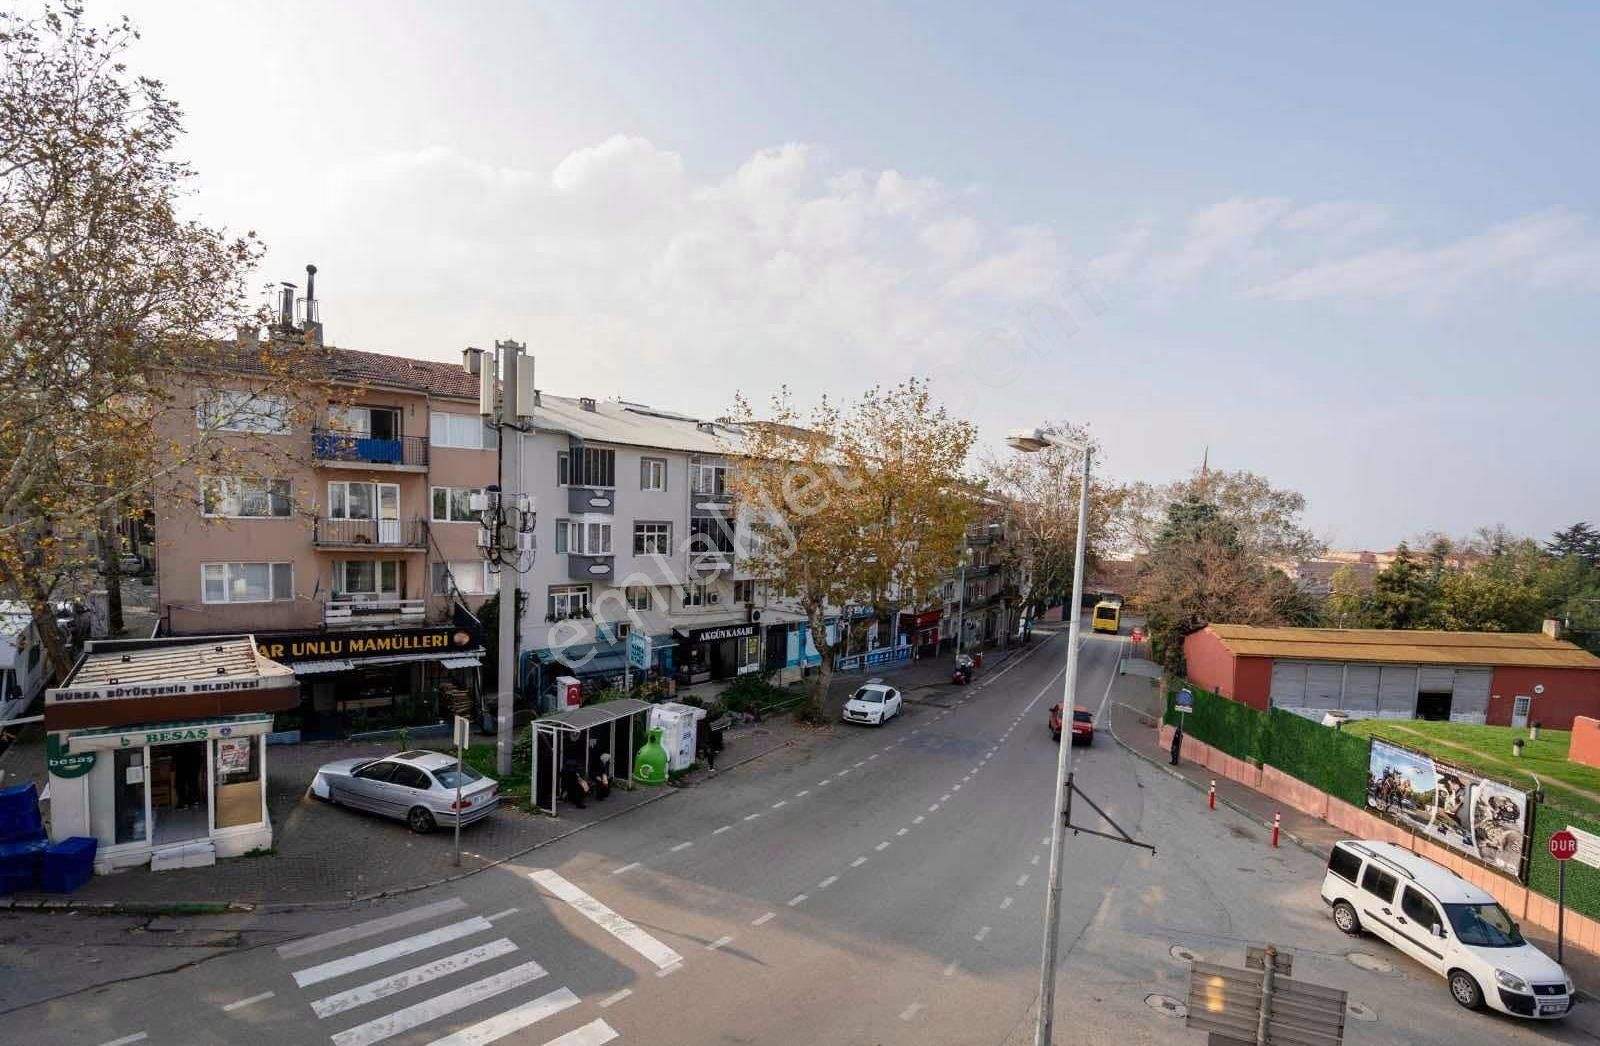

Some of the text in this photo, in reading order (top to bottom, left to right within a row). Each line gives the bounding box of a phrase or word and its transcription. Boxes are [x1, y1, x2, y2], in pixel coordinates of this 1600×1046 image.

[291, 640, 343, 656] UNLU
[349, 632, 449, 653] MAMÜLLERİ
[55, 679, 260, 702] BURSA BÜYÜKŞEHİR BELEDİYESİ
[145, 728, 209, 745] BESAŞ
[49, 756, 94, 766] besaş
[1551, 839, 1576, 852] DUR
